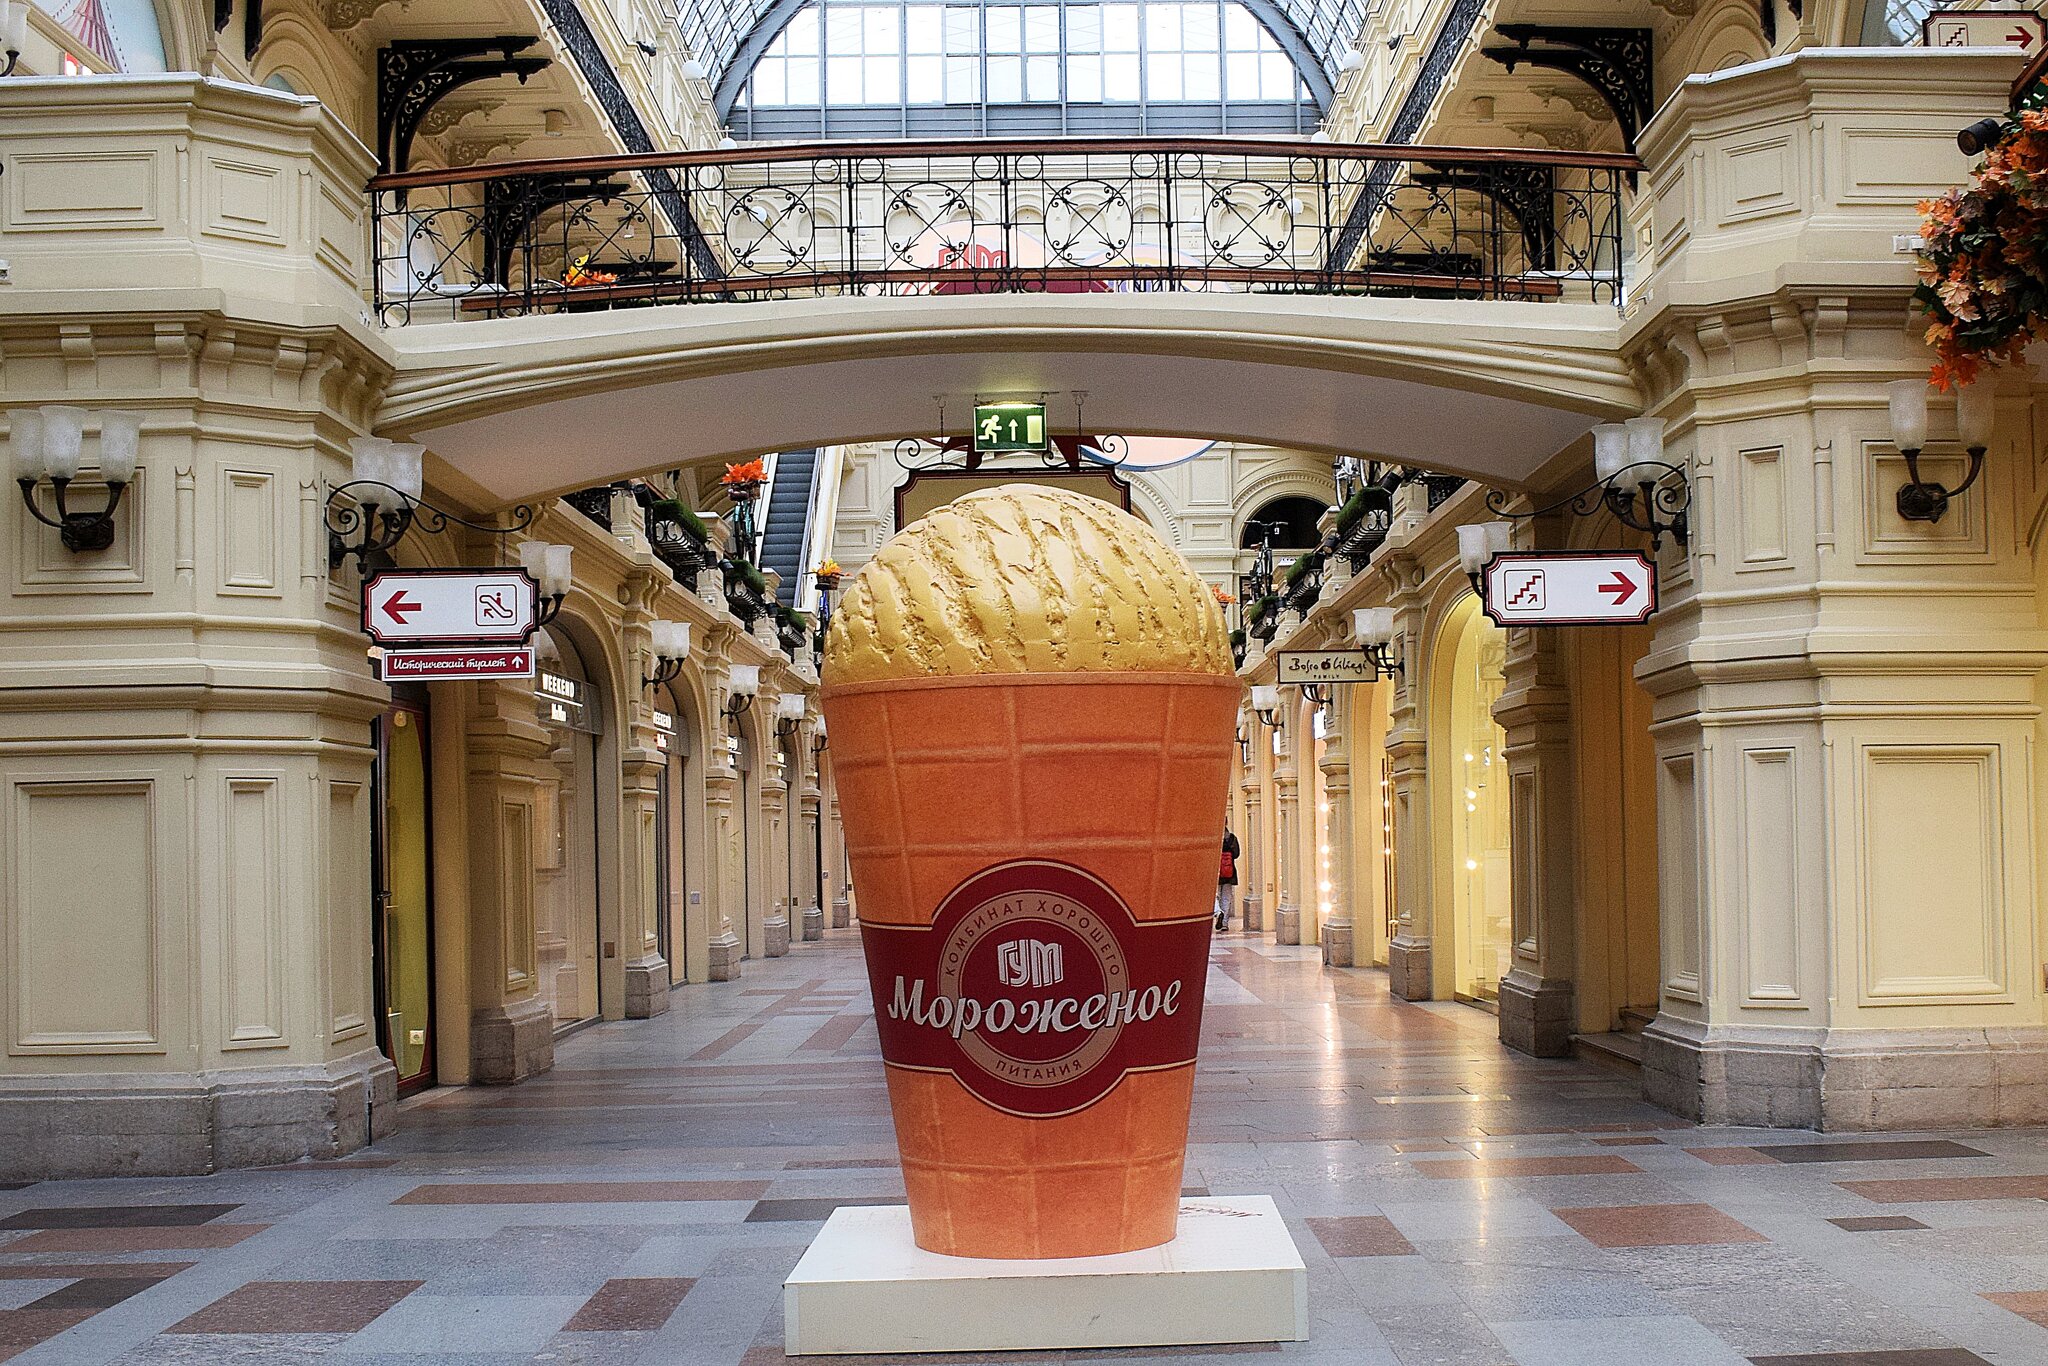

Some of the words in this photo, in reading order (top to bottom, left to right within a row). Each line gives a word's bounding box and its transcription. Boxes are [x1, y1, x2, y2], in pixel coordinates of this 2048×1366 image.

[393, 657, 464, 673] Исторический
[466, 657, 506, 671] туалет
[542, 673, 575, 698] WEEKEND
[945, 900, 1024, 977] КОМБИНАТ
[1037, 899, 1120, 977] ХОРОШЕГО
[887, 975, 1182, 1040] Мороженое
[996, 1058, 1082, 1081] ПИТАНИЯ
